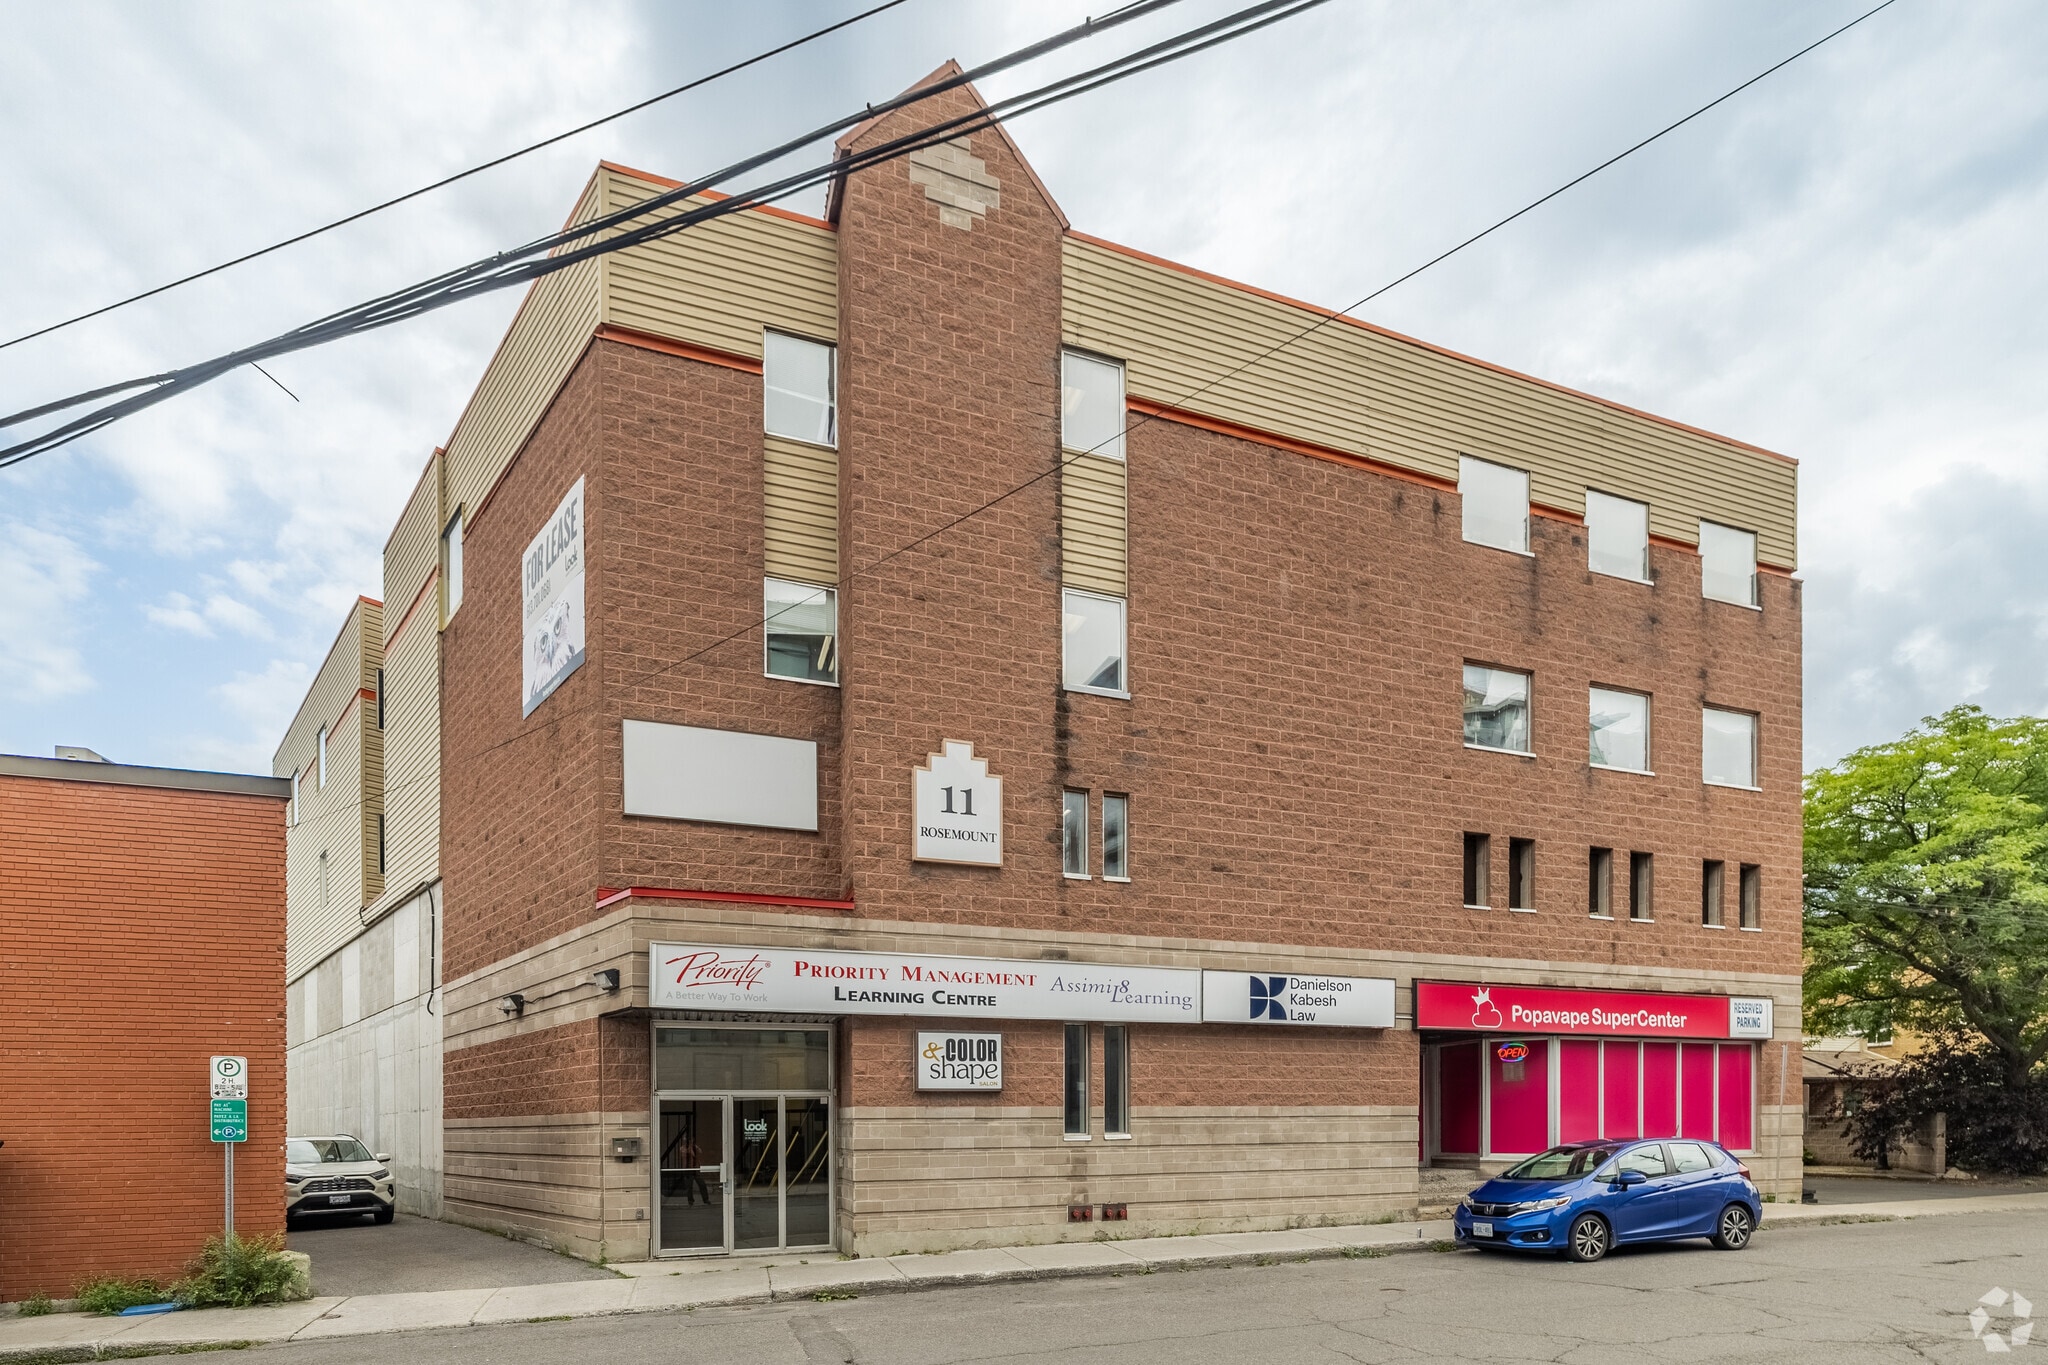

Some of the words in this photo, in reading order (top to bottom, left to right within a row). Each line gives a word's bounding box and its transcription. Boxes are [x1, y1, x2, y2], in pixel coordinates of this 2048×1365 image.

[526, 543, 544, 598] FOR
[545, 497, 578, 573] LEASE
[940, 785, 977, 817] 11
[920, 826, 998, 843] ROSEMOUNT
[1290, 977, 1352, 992] Danielson
[665, 991, 673, 1000] A
[675, 991, 705, 1001] Better
[707, 992, 728, 1003] Way
[730, 993, 741, 1001] To
[743, 993, 768, 1003] Work
[1110, 984, 1193, 1011] Learning
[1290, 993, 1337, 1007] Kabesh
[1290, 1008, 1316, 1021] Law
[1734, 1002, 1763, 1015] RESERVED
[1511, 1004, 1590, 1029] Popavape
[1591, 1007, 1688, 1030] SuperCenter
[1736, 1016, 1761, 1028] PARKING
[945, 1038, 998, 1062] COLOR
[1498, 1047, 1527, 1059] OPEN
[929, 1055, 999, 1085] shape
[744, 1118, 767, 1131] look
